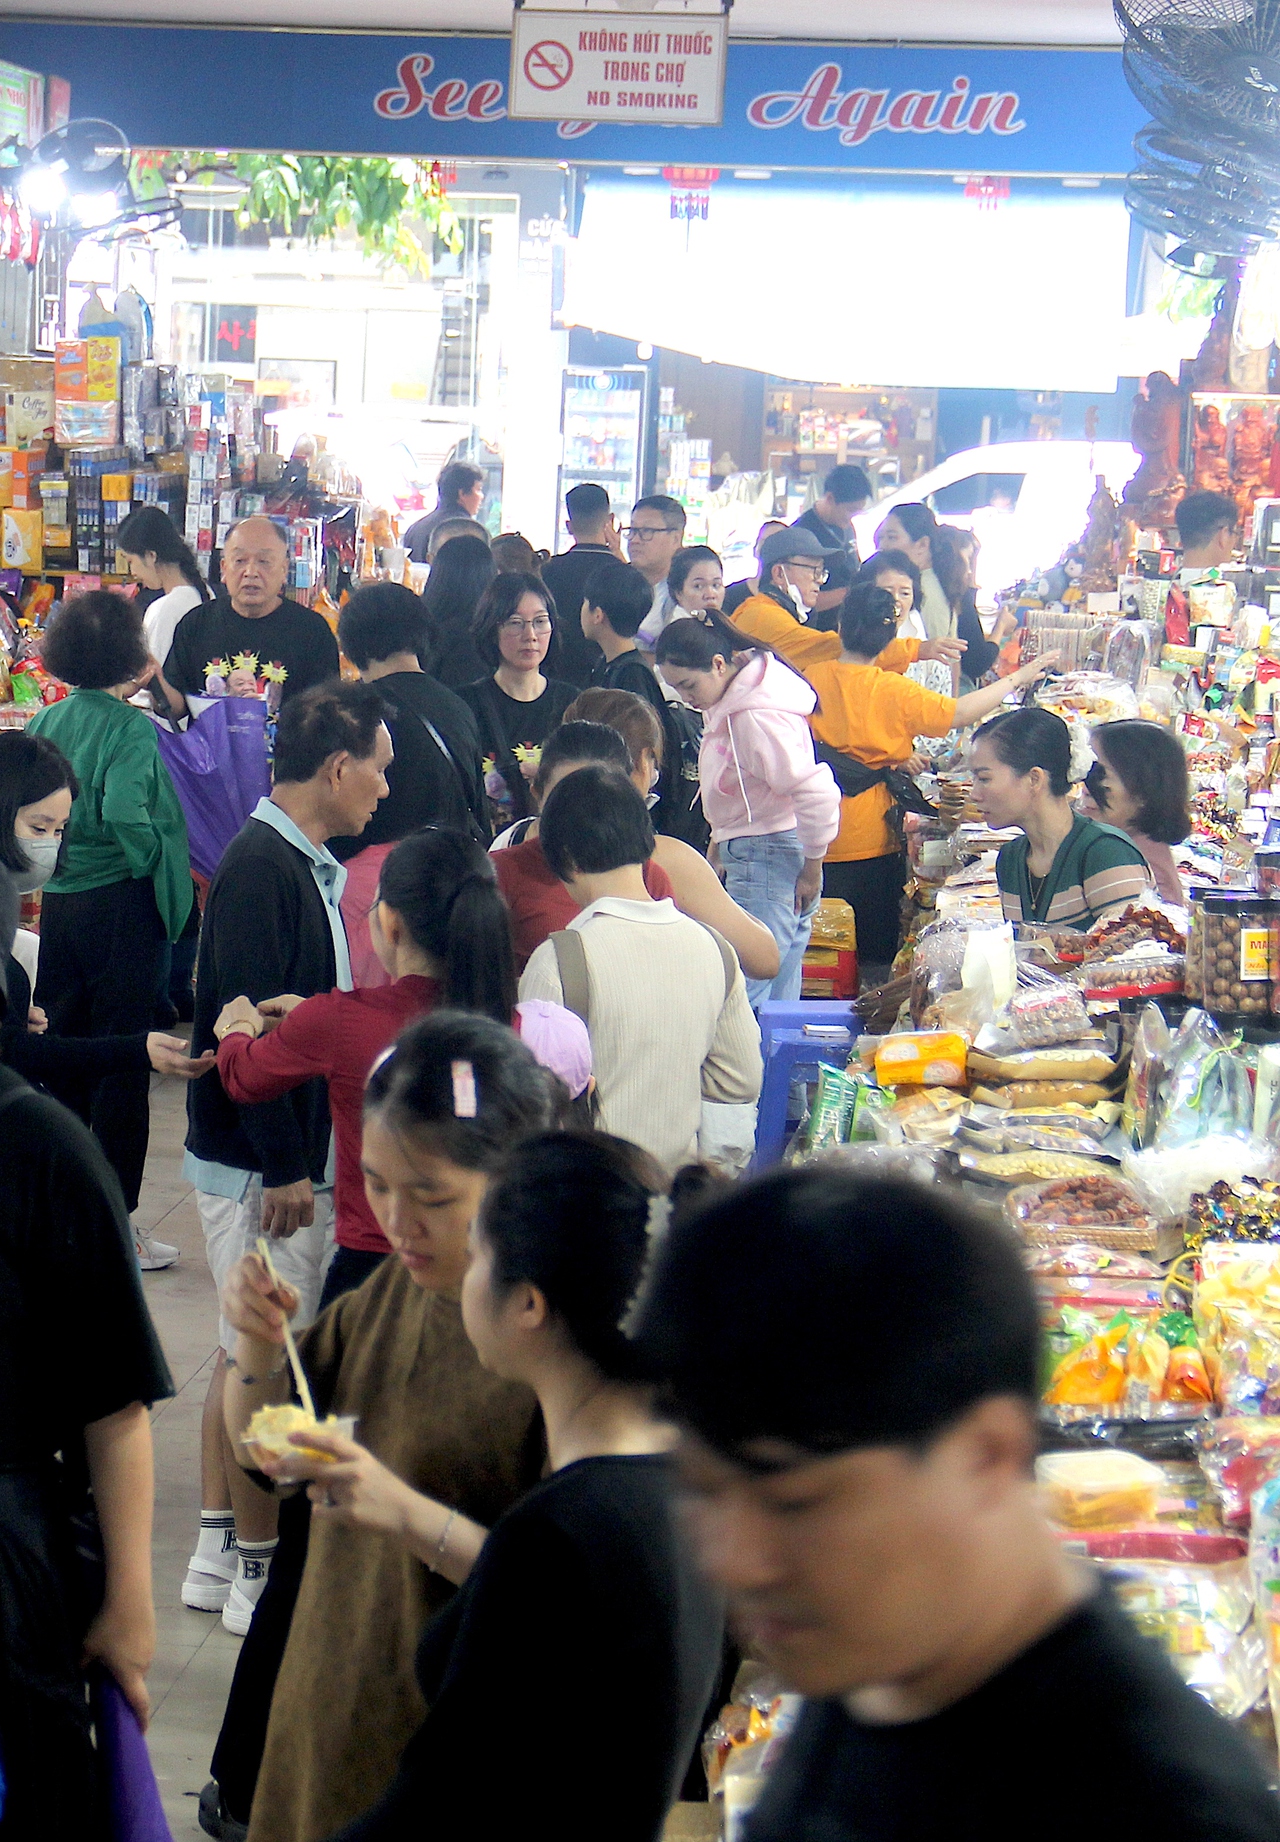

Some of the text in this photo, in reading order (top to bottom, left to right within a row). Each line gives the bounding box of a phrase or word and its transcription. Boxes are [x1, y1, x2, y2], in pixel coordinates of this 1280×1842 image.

[578, 28, 713, 56] KHÔNG HÚT THUỐC
[374, 53, 508, 121] See
[603, 59, 687, 87] TRONG CHỢ
[587, 90, 699, 110] NO SMOKING
[747, 62, 1026, 147] Again
[22, 396, 46, 410] Coffee
